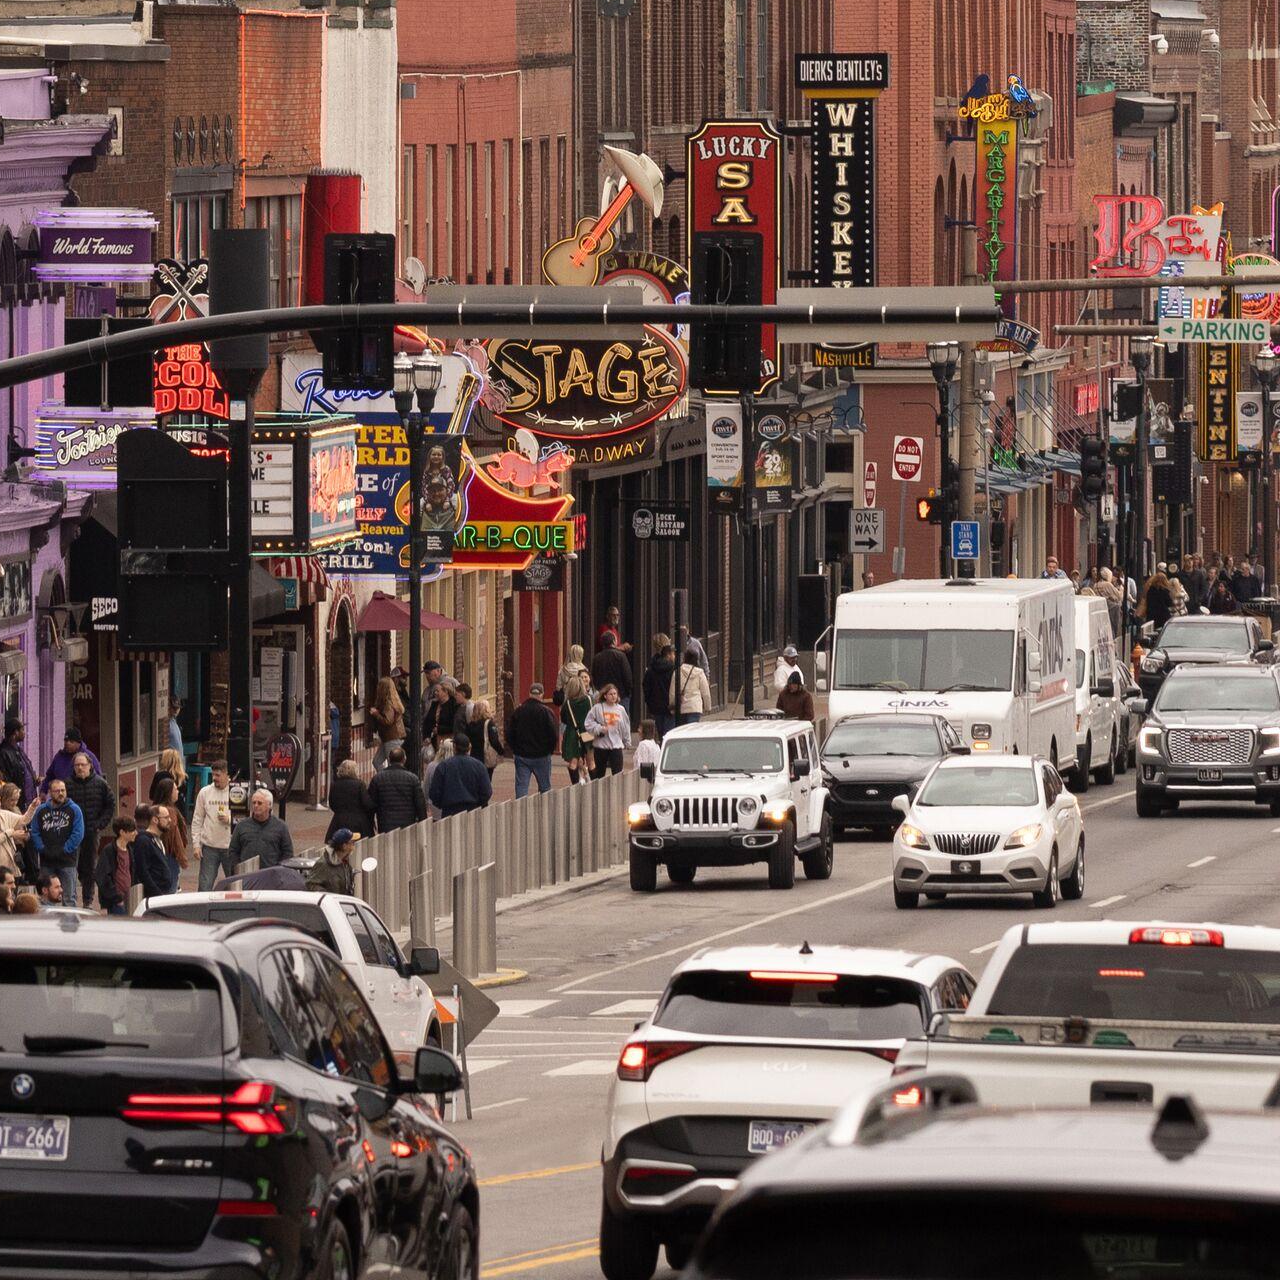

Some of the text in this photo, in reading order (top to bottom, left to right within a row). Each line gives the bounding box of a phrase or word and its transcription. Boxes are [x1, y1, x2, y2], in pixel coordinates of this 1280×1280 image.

[800, 60, 834, 82] DIERKS
[697, 136, 773, 160] LUCKY
[825, 102, 858, 289] WHISKE
[984, 130, 1009, 286] MARGARITAVIL
[53, 237, 134, 255] World Famous
[625, 252, 683, 283] TIME
[1182, 321, 1266, 341] PARKING
[165, 344, 202, 361] THE
[815, 348, 872, 367] NASHVILLE
[487, 339, 678, 413] STAGE
[57, 423, 128, 465] Tootsie
[569, 438, 647, 463] OADWAY
[898, 445, 919, 454] DO NOT
[89, 456, 117, 466] LOUN
[356, 447, 411, 465] RLD
[898, 464, 916, 472] ENTER
[655, 512, 676, 521] LUCKY
[855, 512, 878, 523] ONE
[360, 522, 404, 535] Heaven
[452, 525, 568, 550] R-B-QUE
[655, 528, 681, 536] SALOON
[854, 524, 879, 535] WAY
[320, 554, 373, 569] GRILL
[91, 597, 118, 621] SECO
[25, 1125, 65, 1149] 2667
